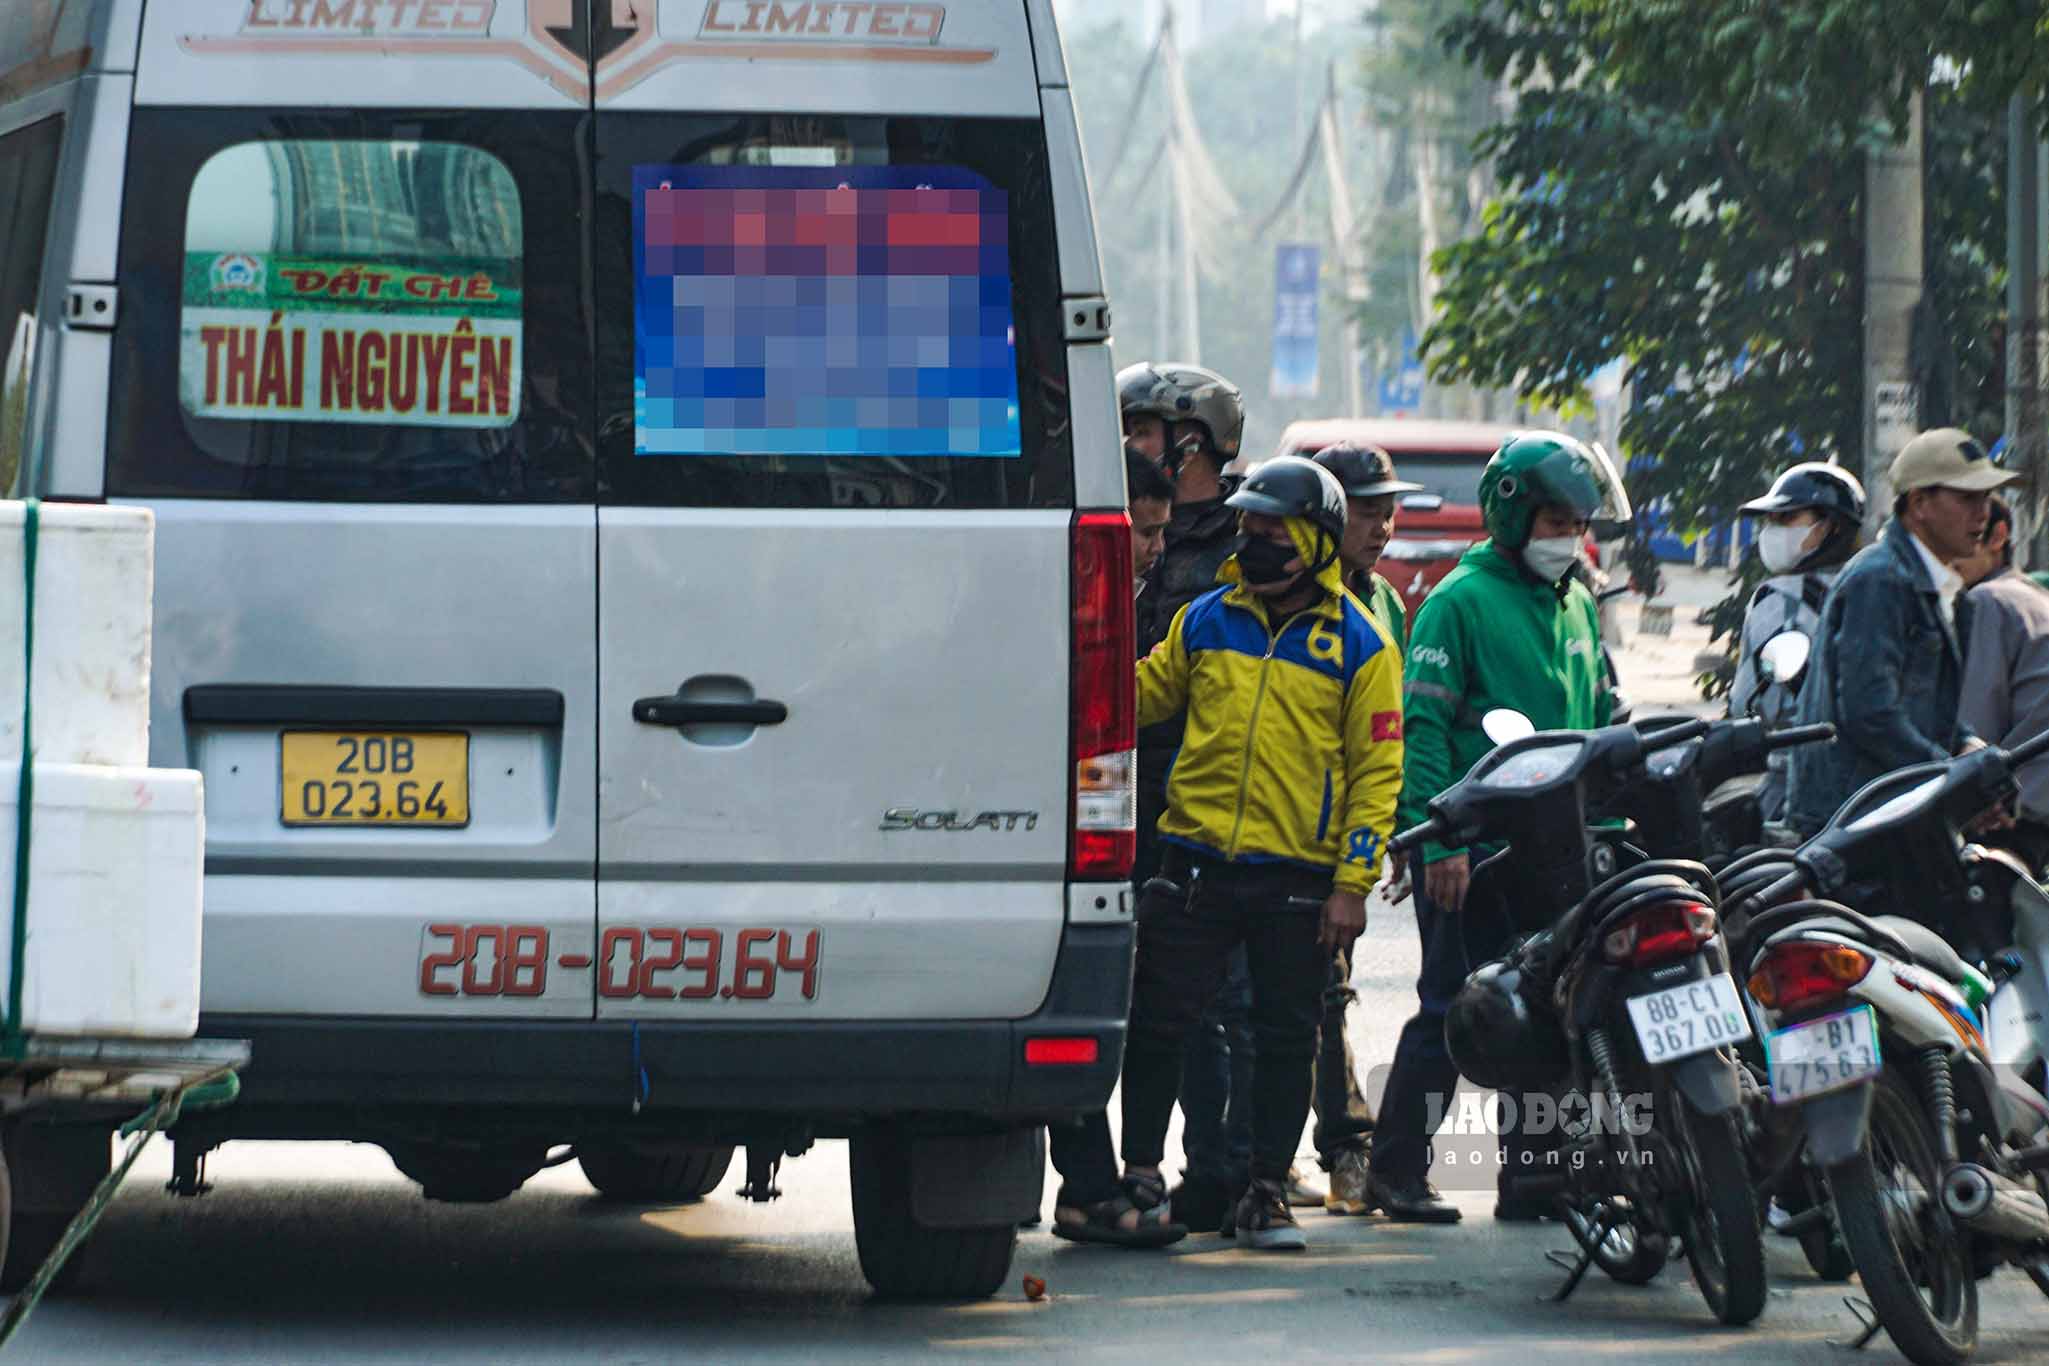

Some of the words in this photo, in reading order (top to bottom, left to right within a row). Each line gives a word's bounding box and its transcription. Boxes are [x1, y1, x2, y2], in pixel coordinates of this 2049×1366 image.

[703, 0, 942, 37] LIMITED
[201, 309, 306, 409] THÁI
[319, 315, 514, 417] NGUYÊN
[1411, 644, 1450, 668] Grab
[336, 735, 415, 774] 20B
[302, 780, 448, 818] 023.64
[878, 807, 1039, 832] SOLATI
[1646, 981, 1720, 1024] 88-C1
